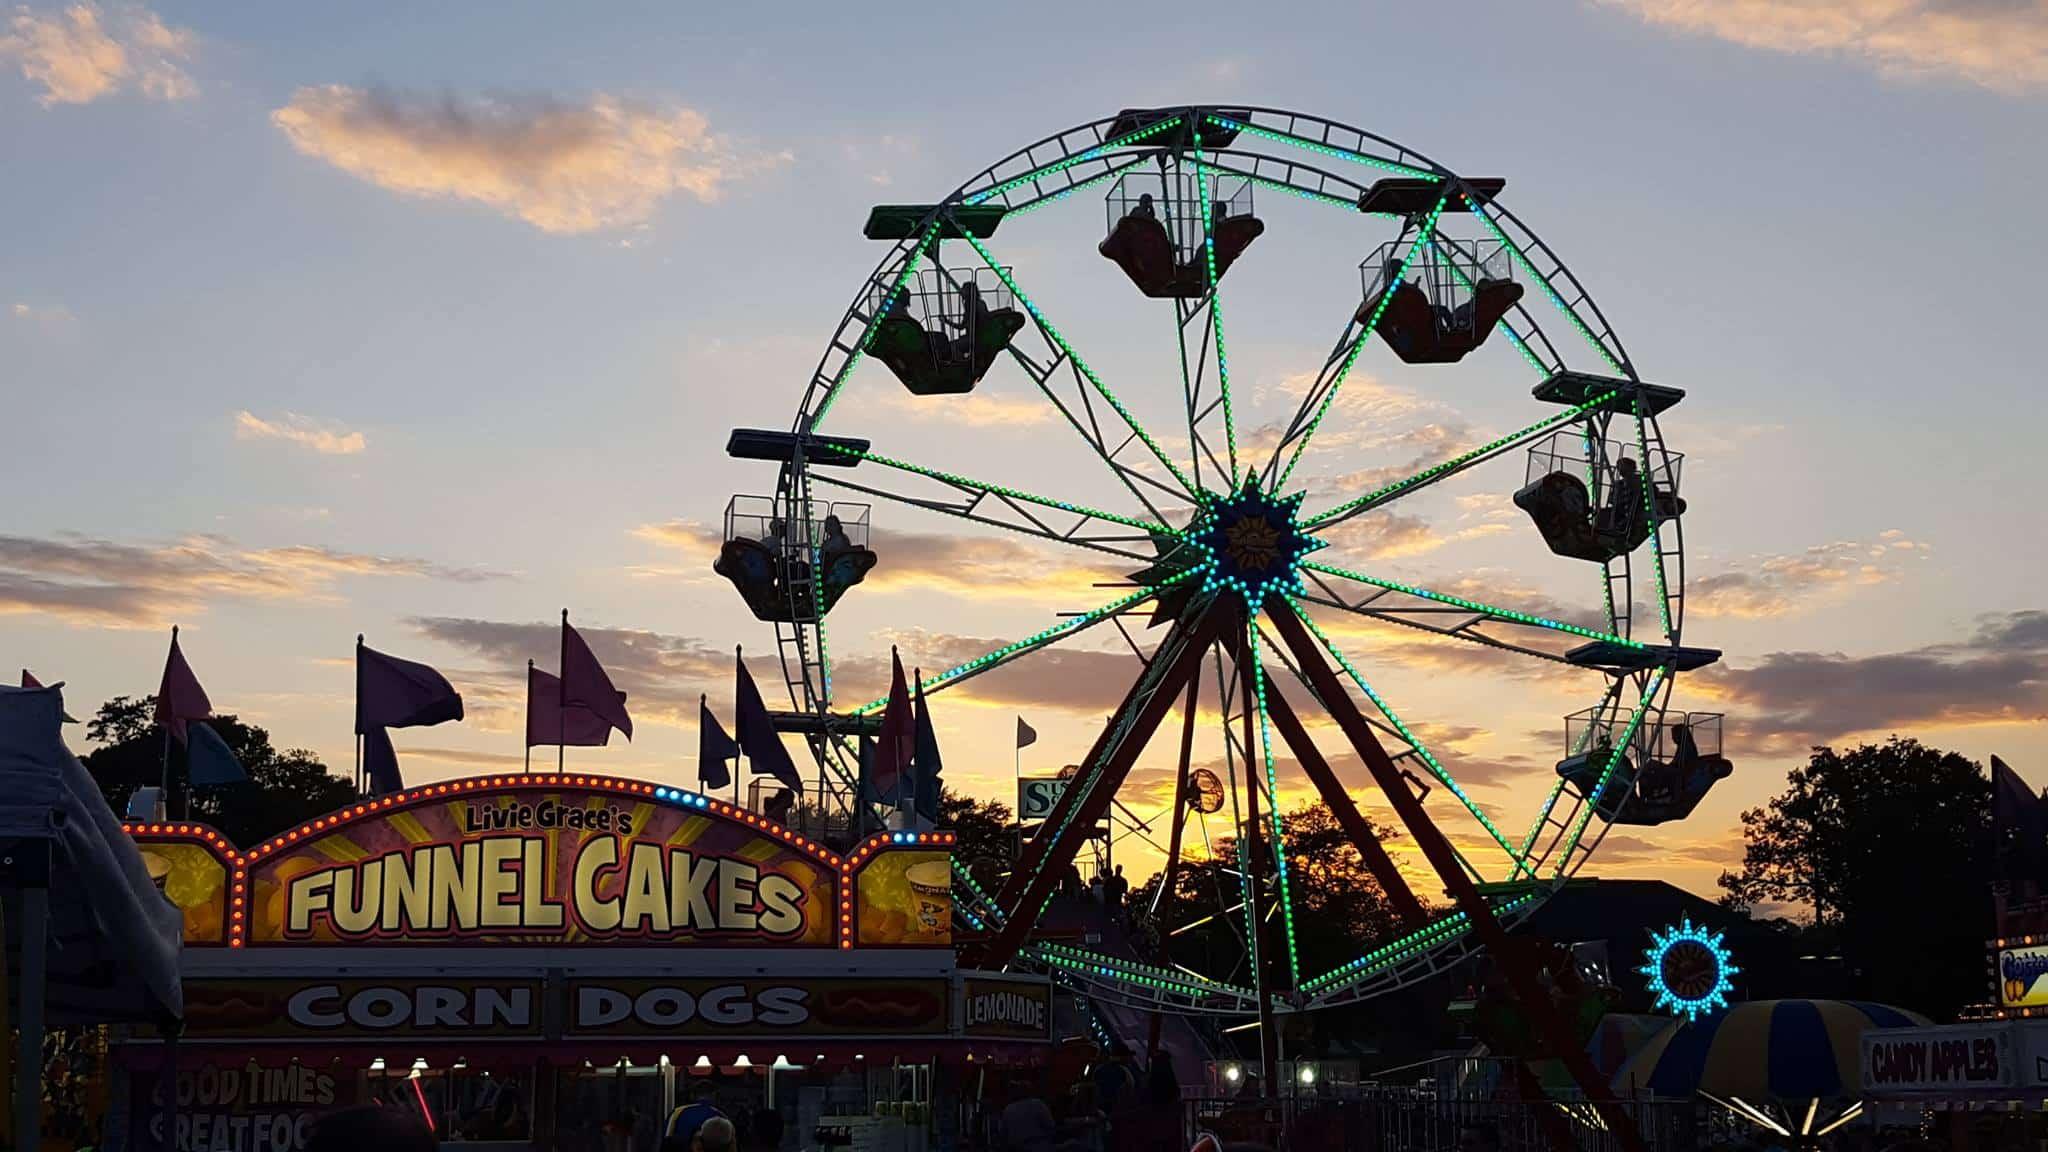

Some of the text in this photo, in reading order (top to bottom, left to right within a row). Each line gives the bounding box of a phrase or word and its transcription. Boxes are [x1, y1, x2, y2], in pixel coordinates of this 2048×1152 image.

[466, 801, 633, 834] Livie Grace's
[289, 836, 803, 934] FUNNEL CAKES
[287, 984, 809, 1028] CORN DOGS
[966, 992, 1045, 1030] LEMONADE
[1872, 1041, 1926, 1082] CANDY
[1932, 1038, 1998, 1081] APPLES
[248, 1064, 336, 1104] TIMES
